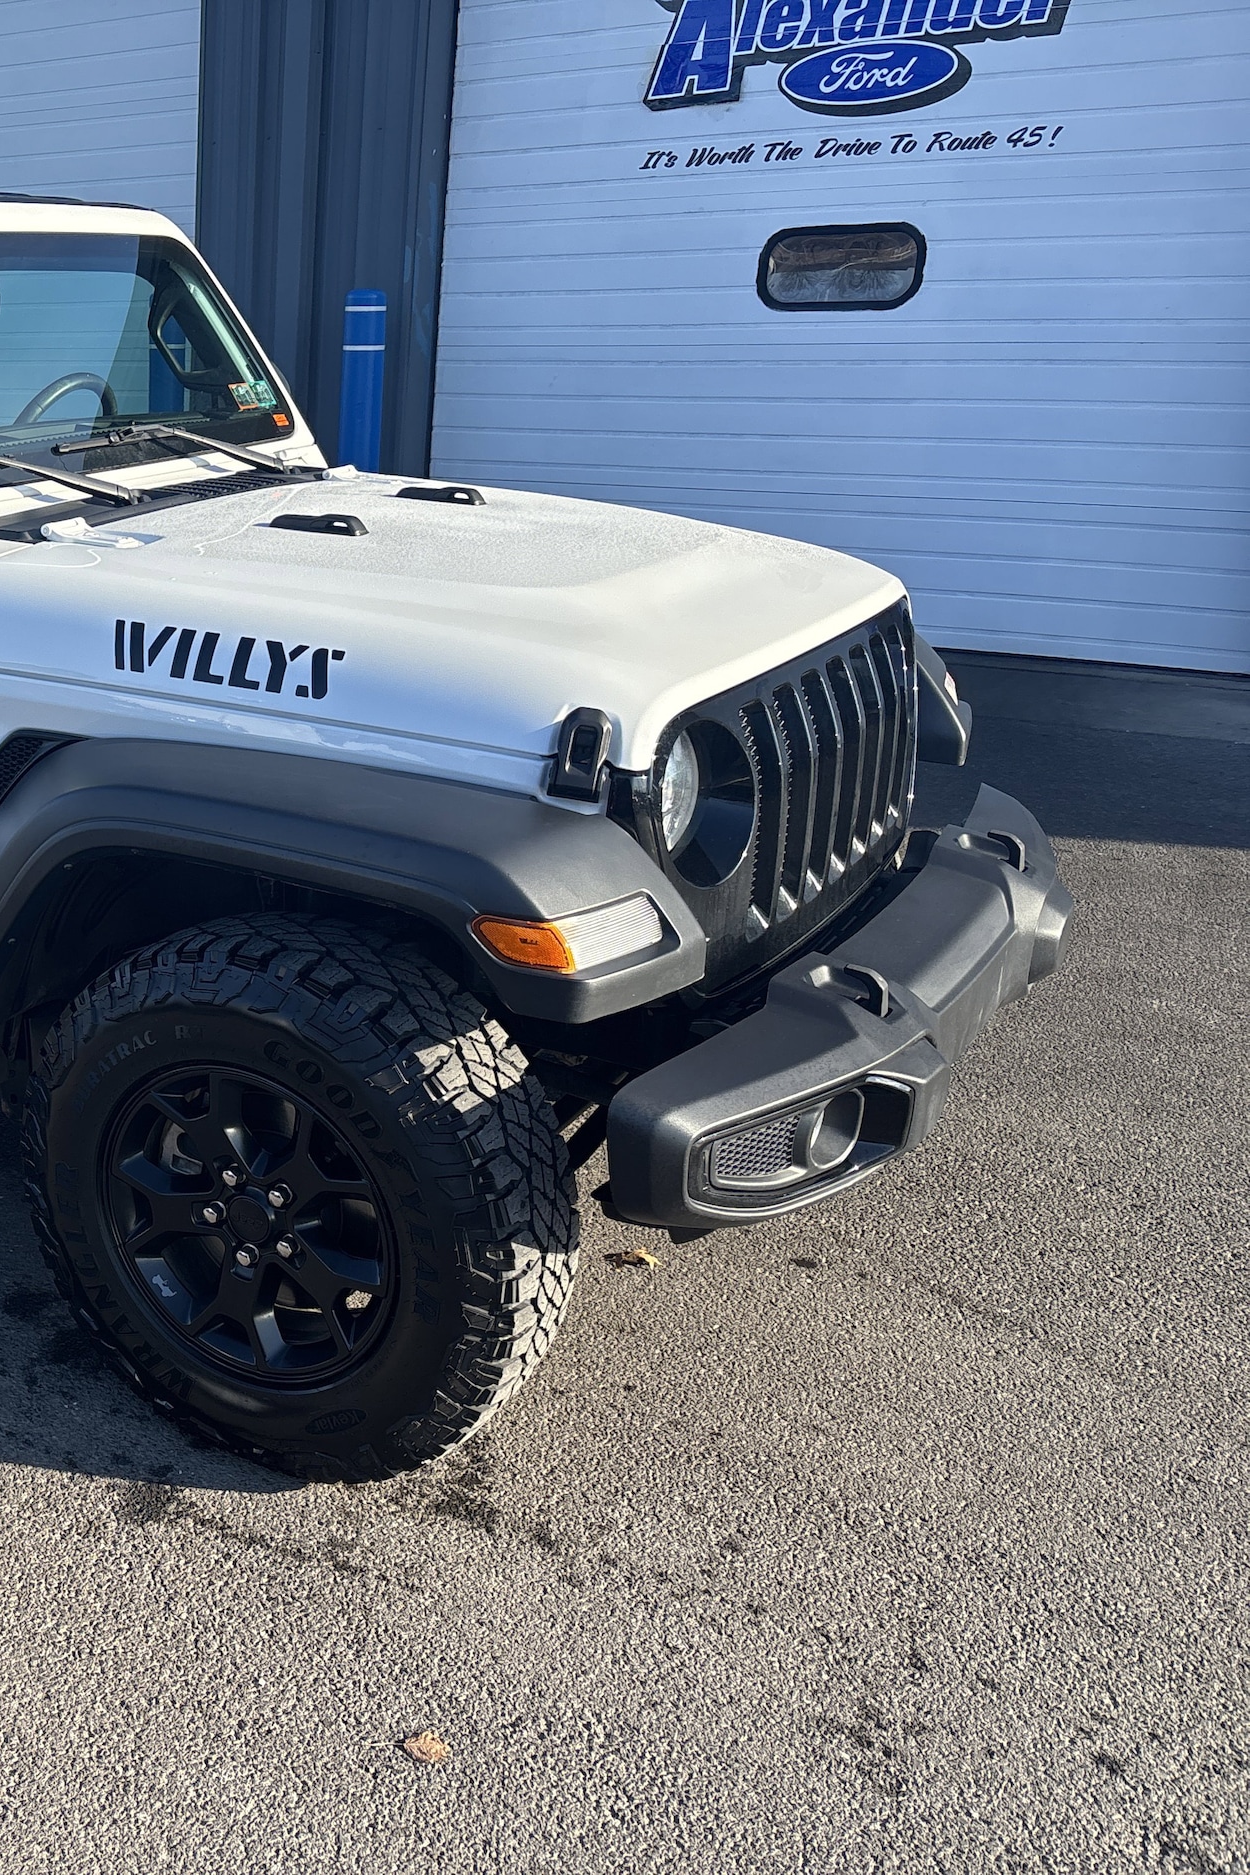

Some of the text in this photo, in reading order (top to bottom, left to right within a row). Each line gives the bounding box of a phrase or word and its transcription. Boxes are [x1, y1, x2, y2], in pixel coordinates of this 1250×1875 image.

[819, 50, 918, 93] Ford
[638, 150, 678, 170] It's
[684, 143, 756, 168] Worth
[763, 140, 803, 163] The
[814, 136, 882, 160] Drive
[890, 133, 918, 155] To
[925, 130, 998, 153] Route
[114, 618, 346, 700] WILLYS
